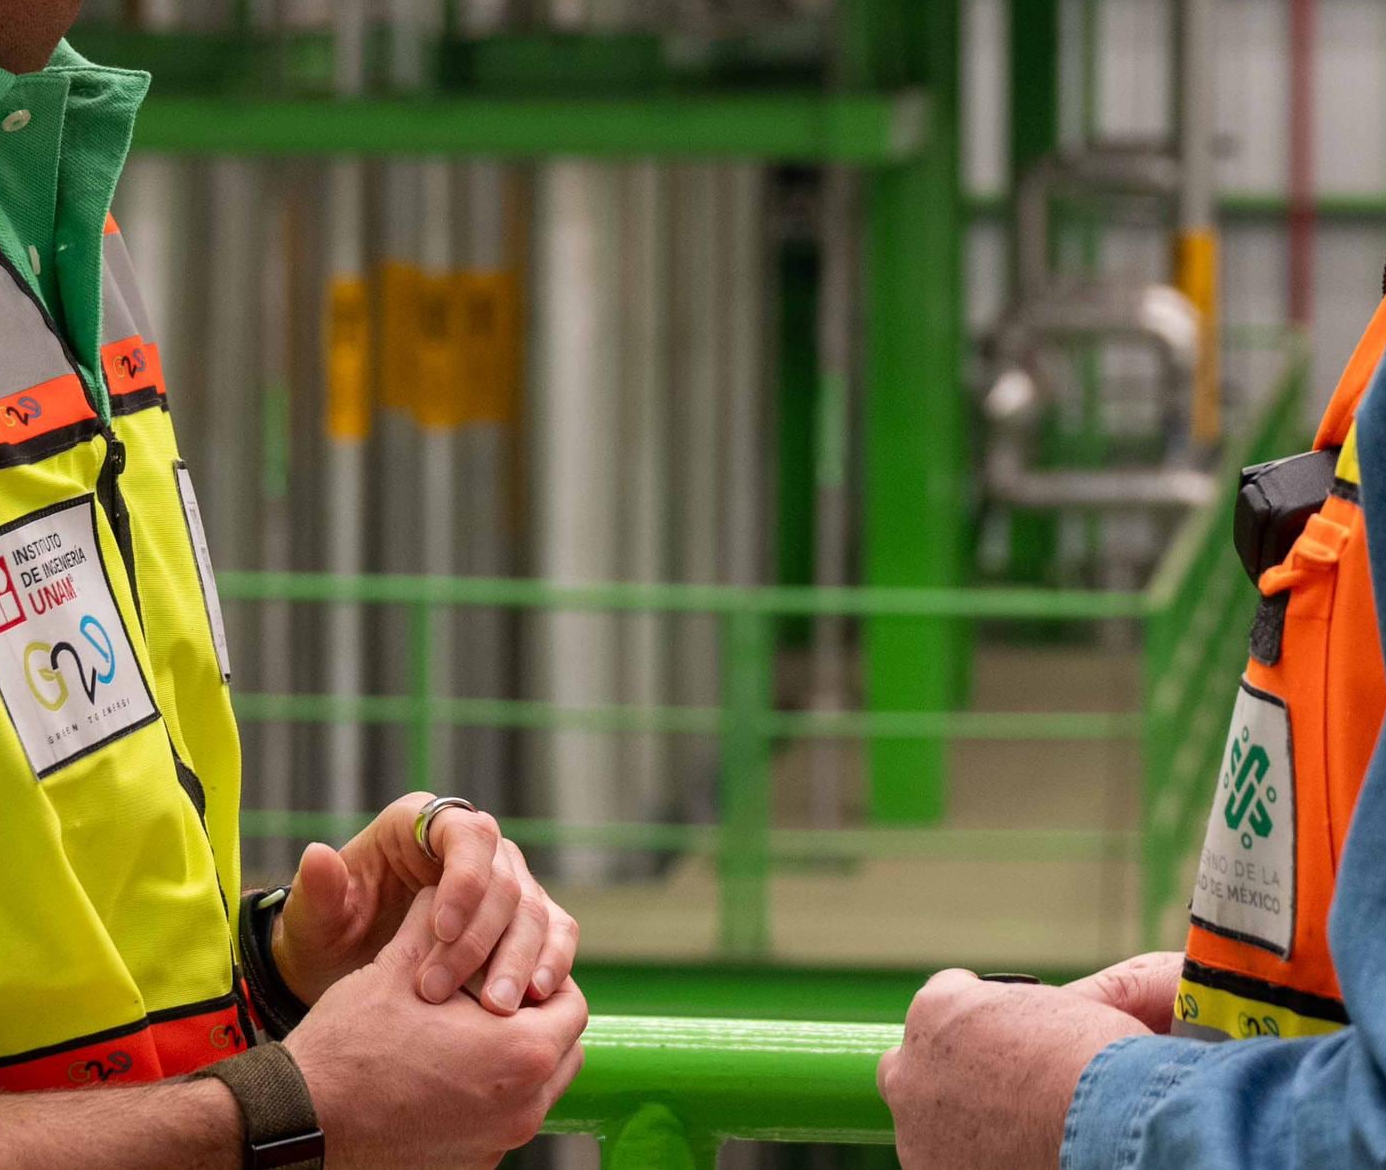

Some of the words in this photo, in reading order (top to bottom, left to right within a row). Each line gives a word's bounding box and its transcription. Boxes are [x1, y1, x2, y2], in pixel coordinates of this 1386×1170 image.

[20, 566, 43, 588] DE
[1234, 860, 1256, 882] DE
[1262, 867, 1280, 887] LA
[1227, 881, 1280, 915] MÉXICO
